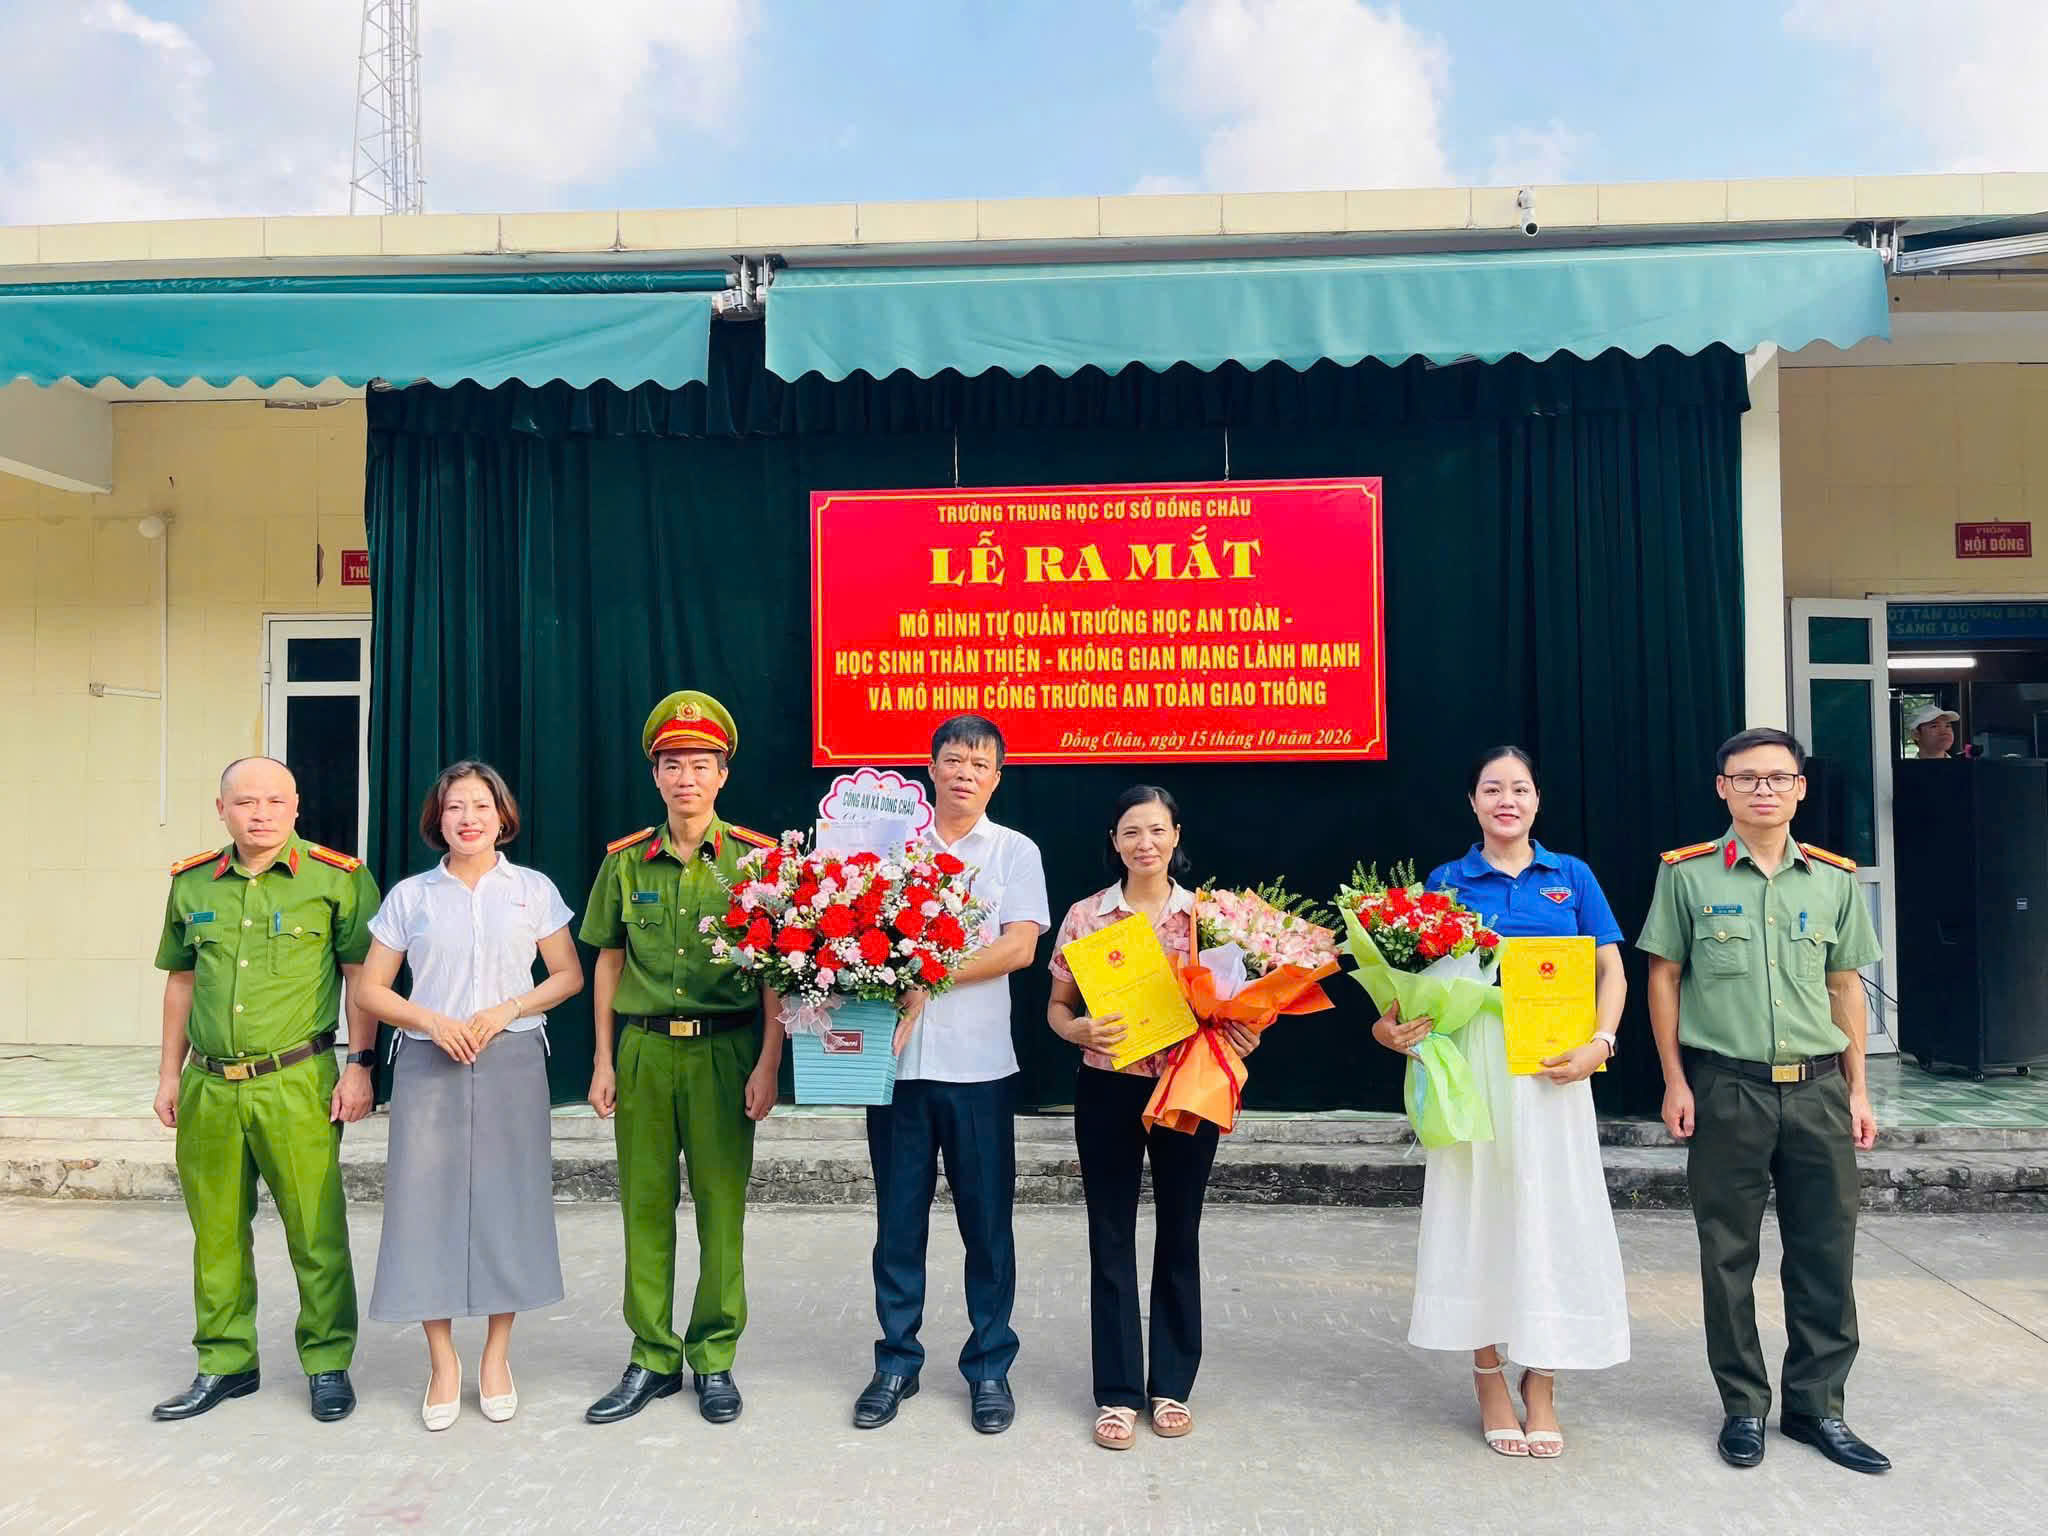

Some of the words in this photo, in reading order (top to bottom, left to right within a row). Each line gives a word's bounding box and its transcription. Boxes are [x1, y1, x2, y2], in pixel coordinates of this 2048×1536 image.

[937, 501, 1003, 523] TRƯỜNG
[1007, 503, 1062, 521] TRUNG
[1065, 502, 1099, 524] HỌC
[1103, 500, 1125, 519] CƠ
[1129, 495, 1152, 520] SỞ
[1206, 495, 1251, 517] CHÂU
[929, 529, 1005, 586] LỄ
[1023, 543, 1112, 582] RA
[1124, 525, 1261, 580] MẮT
[900, 608, 929, 638] MÔ
[934, 607, 981, 637] HÌNH
[985, 609, 1010, 641] TỰ
[1013, 603, 1066, 639] QUẢN
[1070, 604, 1147, 635] TRƯỜNG
[1152, 608, 1191, 639] HỌC
[1196, 608, 1223, 633] AN
[1228, 601, 1280, 632] TOÀN
[1284, 616, 1293, 624] -
[835, 650, 873, 680] HỌC
[879, 649, 925, 675] SINH
[929, 645, 979, 673] THÂN
[984, 644, 1040, 677] THIỆN
[1057, 642, 1124, 672] KHÔNG
[1128, 646, 1175, 671] GIAN
[1181, 643, 1239, 675] MẠNG
[1244, 639, 1296, 669] LÀNH
[1301, 642, 1361, 673] MẠNH
[868, 682, 893, 711] VÀ
[897, 681, 928, 711] MÔ
[932, 681, 978, 710] HÌNH
[983, 676, 1036, 710] CỔNG
[1040, 679, 1118, 709] TRƯỜNG
[1122, 683, 1149, 708] AN
[1153, 677, 1205, 708] TOÀN
[1210, 682, 1256, 706] GIAO
[1261, 676, 1327, 706] THÔNG
[1102, 730, 1147, 748] Châu,
[1150, 730, 1186, 750] ngày
[1189, 730, 1208, 747] 15
[1209, 730, 1255, 749] tháng
[1258, 729, 1276, 746] 10
[1278, 729, 1312, 745] năm
[1314, 728, 1353, 745] 2026
[842, 790, 861, 807] CÔNG
[860, 792, 870, 808] AN
